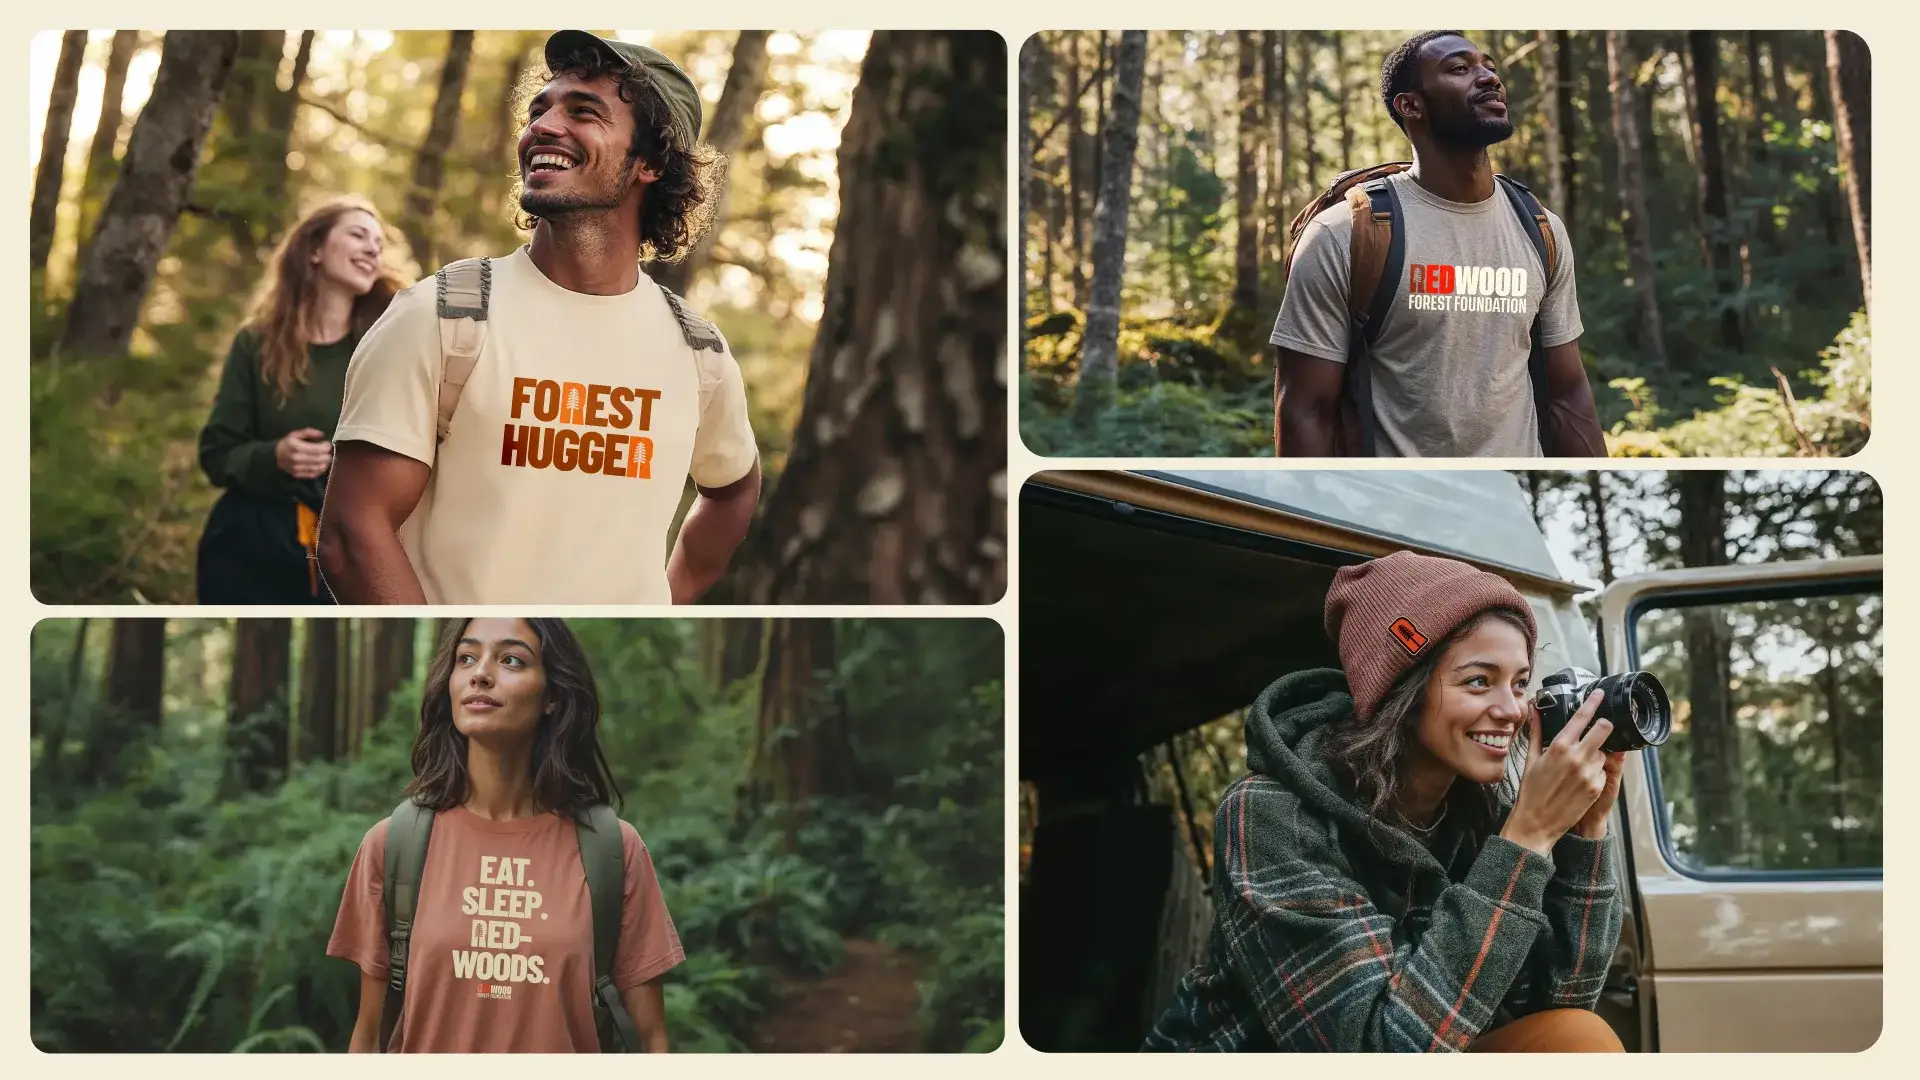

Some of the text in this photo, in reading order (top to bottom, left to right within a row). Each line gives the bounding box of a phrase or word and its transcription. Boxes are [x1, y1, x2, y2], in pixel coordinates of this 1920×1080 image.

[1409, 264, 1527, 297] REDWOOD
[1408, 294, 1527, 313] FOREST FOUNDATION
[511, 377, 661, 431] FOREST
[501, 424, 654, 480] HUGGER
[480, 856, 535, 887] EAT.
[462, 886, 548, 920] SLEEP.
[471, 919, 532, 949] RED-
[452, 950, 550, 984] WOODS.
